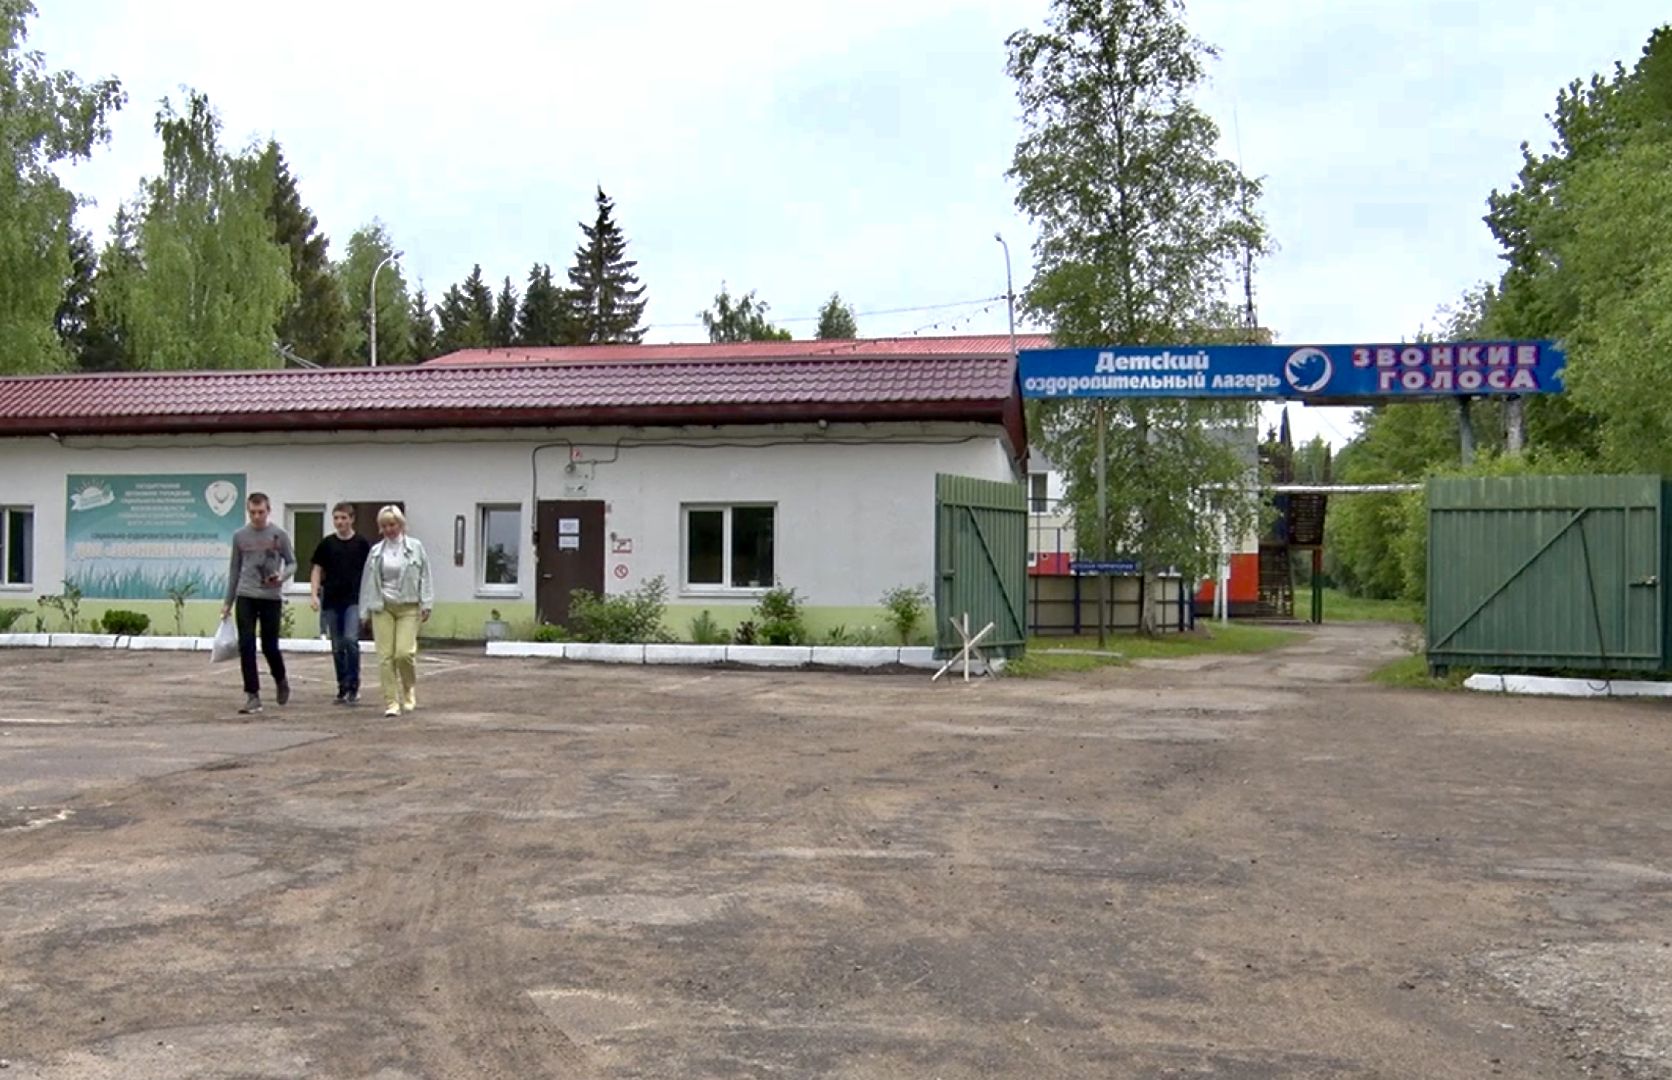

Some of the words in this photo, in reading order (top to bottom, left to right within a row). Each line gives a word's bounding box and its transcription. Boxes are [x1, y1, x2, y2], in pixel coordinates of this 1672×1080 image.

[1095, 351, 1209, 373] Детский
[1353, 345, 1538, 367] ЗВОНКИЕ
[1024, 371, 1206, 395] оздоровительный
[1211, 373, 1281, 392] лагерь
[1379, 368, 1537, 390] ГОЛОСА
